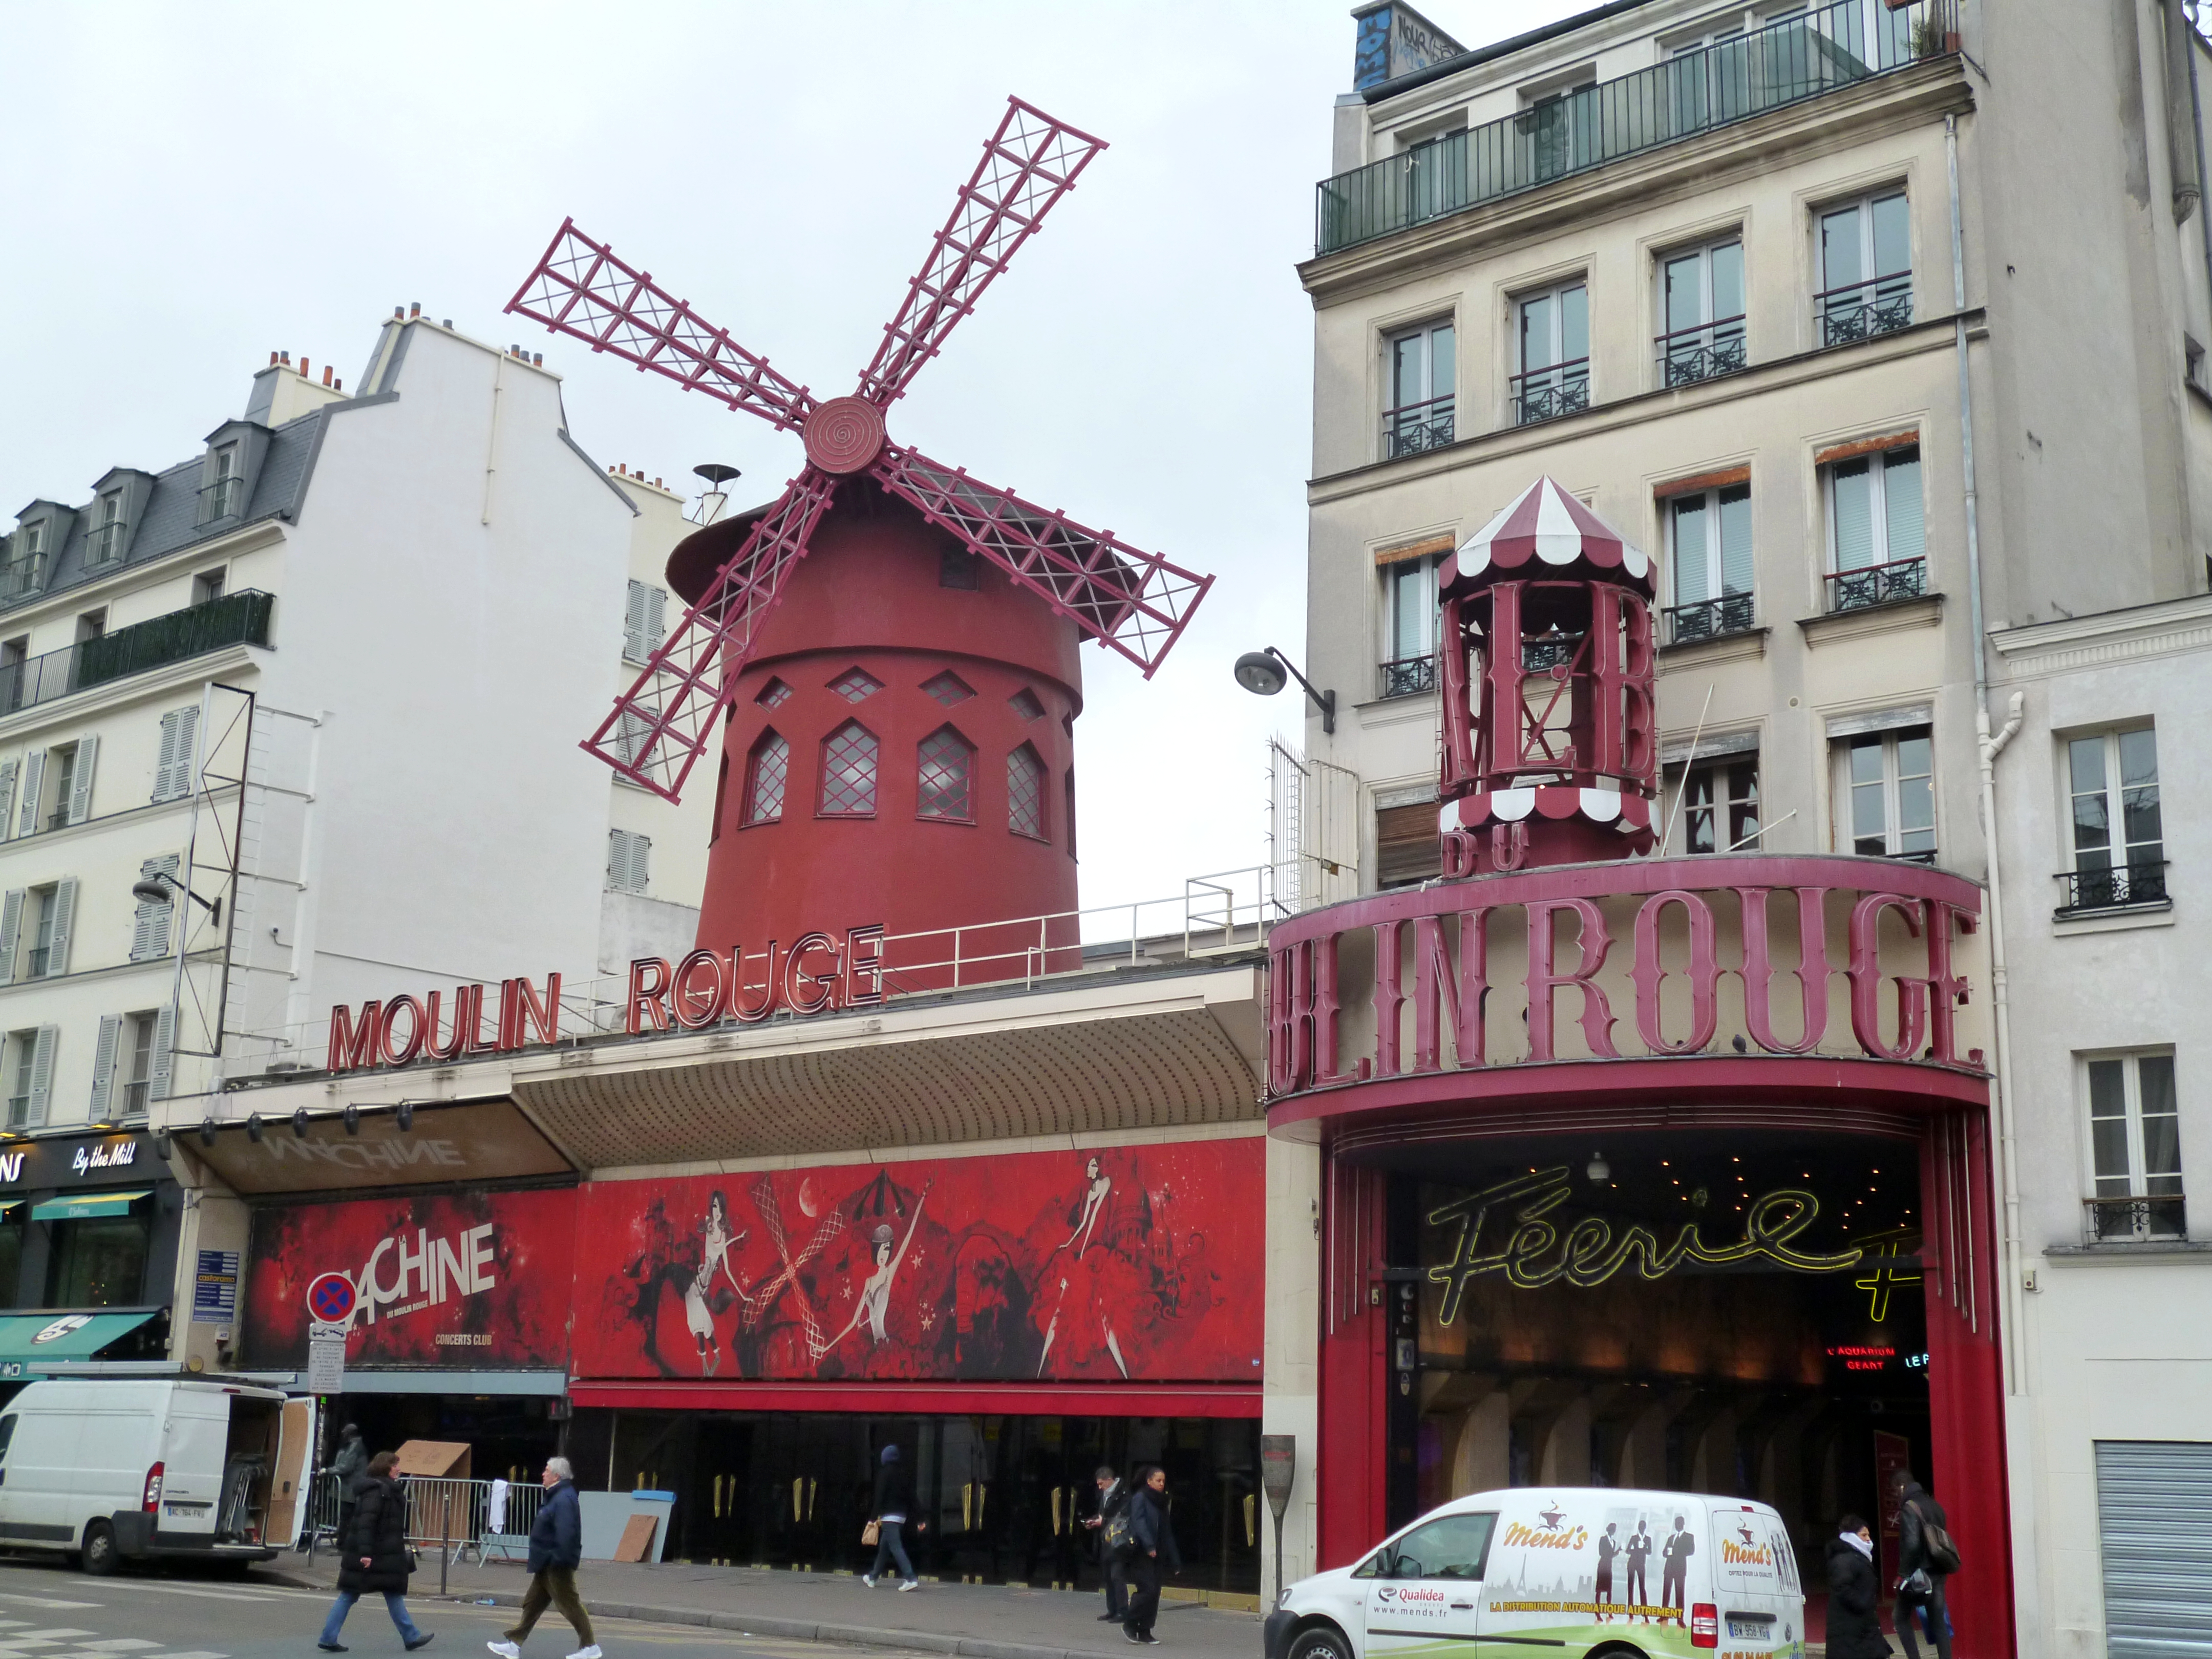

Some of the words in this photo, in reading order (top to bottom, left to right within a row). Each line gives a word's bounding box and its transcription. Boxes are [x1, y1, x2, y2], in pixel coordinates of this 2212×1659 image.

[1441, 821, 1530, 878] DU
[1521, 887, 1986, 1075] ROUGE
[327, 972, 562, 1072] MOULIN
[625, 923, 889, 1034] ROUGE
[72, 1146, 89, 1176] By
[89, 1144, 109, 1167] the
[108, 1141, 136, 1166] Mill
[398, 1235, 407, 1245] LA
[1427, 1165, 1863, 1327] Féerie
[387, 1311, 394, 1320] DU
[394, 1304, 412, 1317] MOULIN
[413, 1300, 428, 1311] ROUGE
[436, 1333, 472, 1346] CONCERTS
[473, 1334, 492, 1346] CLUB
[1905, 1356, 1921, 1368] LE
[1503, 1522, 1588, 1550] Mend's
[1722, 1538, 1772, 1566] Mend's
[1399, 1588, 1444, 1604] Qualidea
[1373, 1607, 1448, 1618] www.mends.fr
[1490, 1602, 1502, 1612] LA
[1503, 1602, 1561, 1612] DISTRIBUTION
[1562, 1602, 1626, 1615] AUTOMATIQUE
[1627, 1605, 1683, 1618] AUTREMENT
